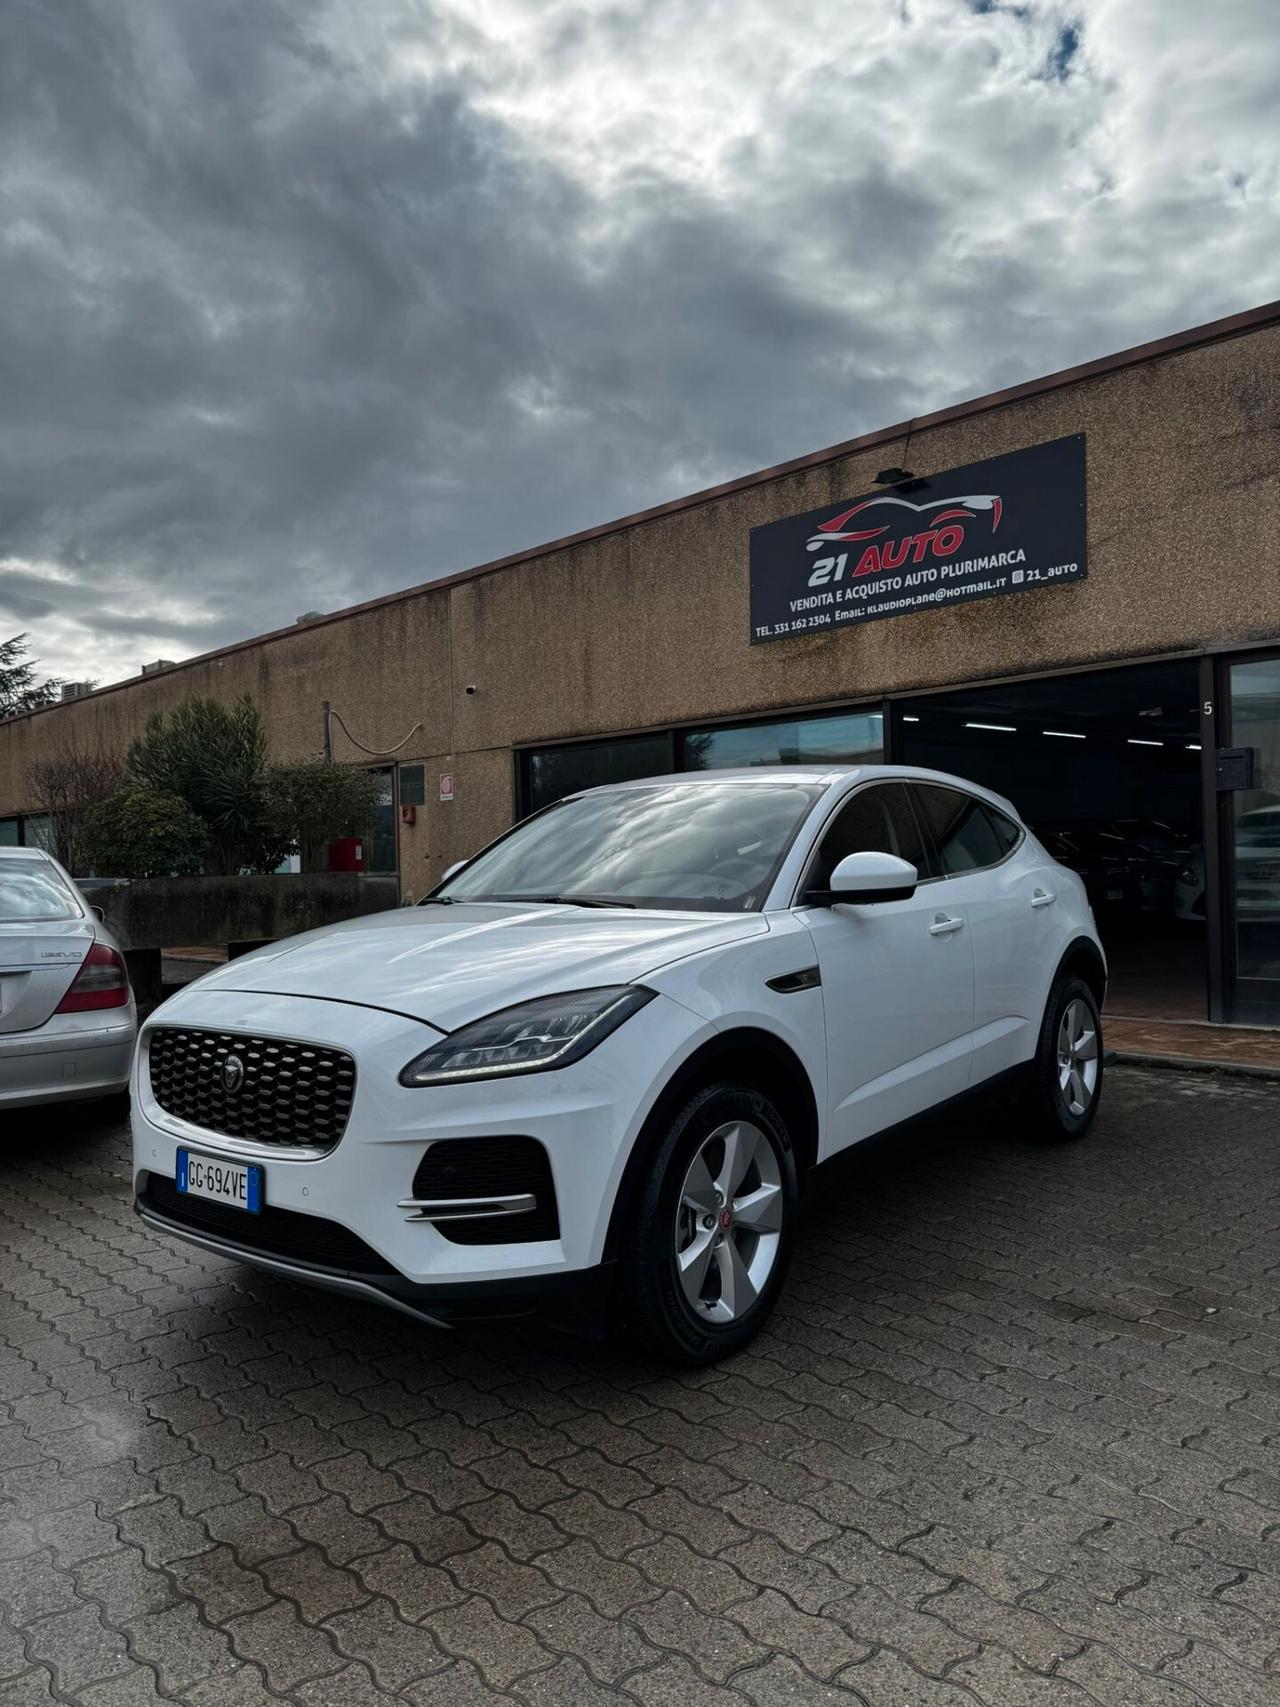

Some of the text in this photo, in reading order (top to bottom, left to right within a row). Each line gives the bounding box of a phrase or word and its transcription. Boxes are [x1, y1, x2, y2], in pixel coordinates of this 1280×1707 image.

[808, 525, 965, 587] 21 AUTO
[789, 548, 1026, 612] VENDITA E ACQUISTO AUTO PLURIMARCA
[755, 625, 773, 637] TEL.
[774, 622, 790, 634] 331
[791, 618, 807, 630] 162
[808, 613, 832, 626] 2304
[1203, 701, 1213, 715] 5
